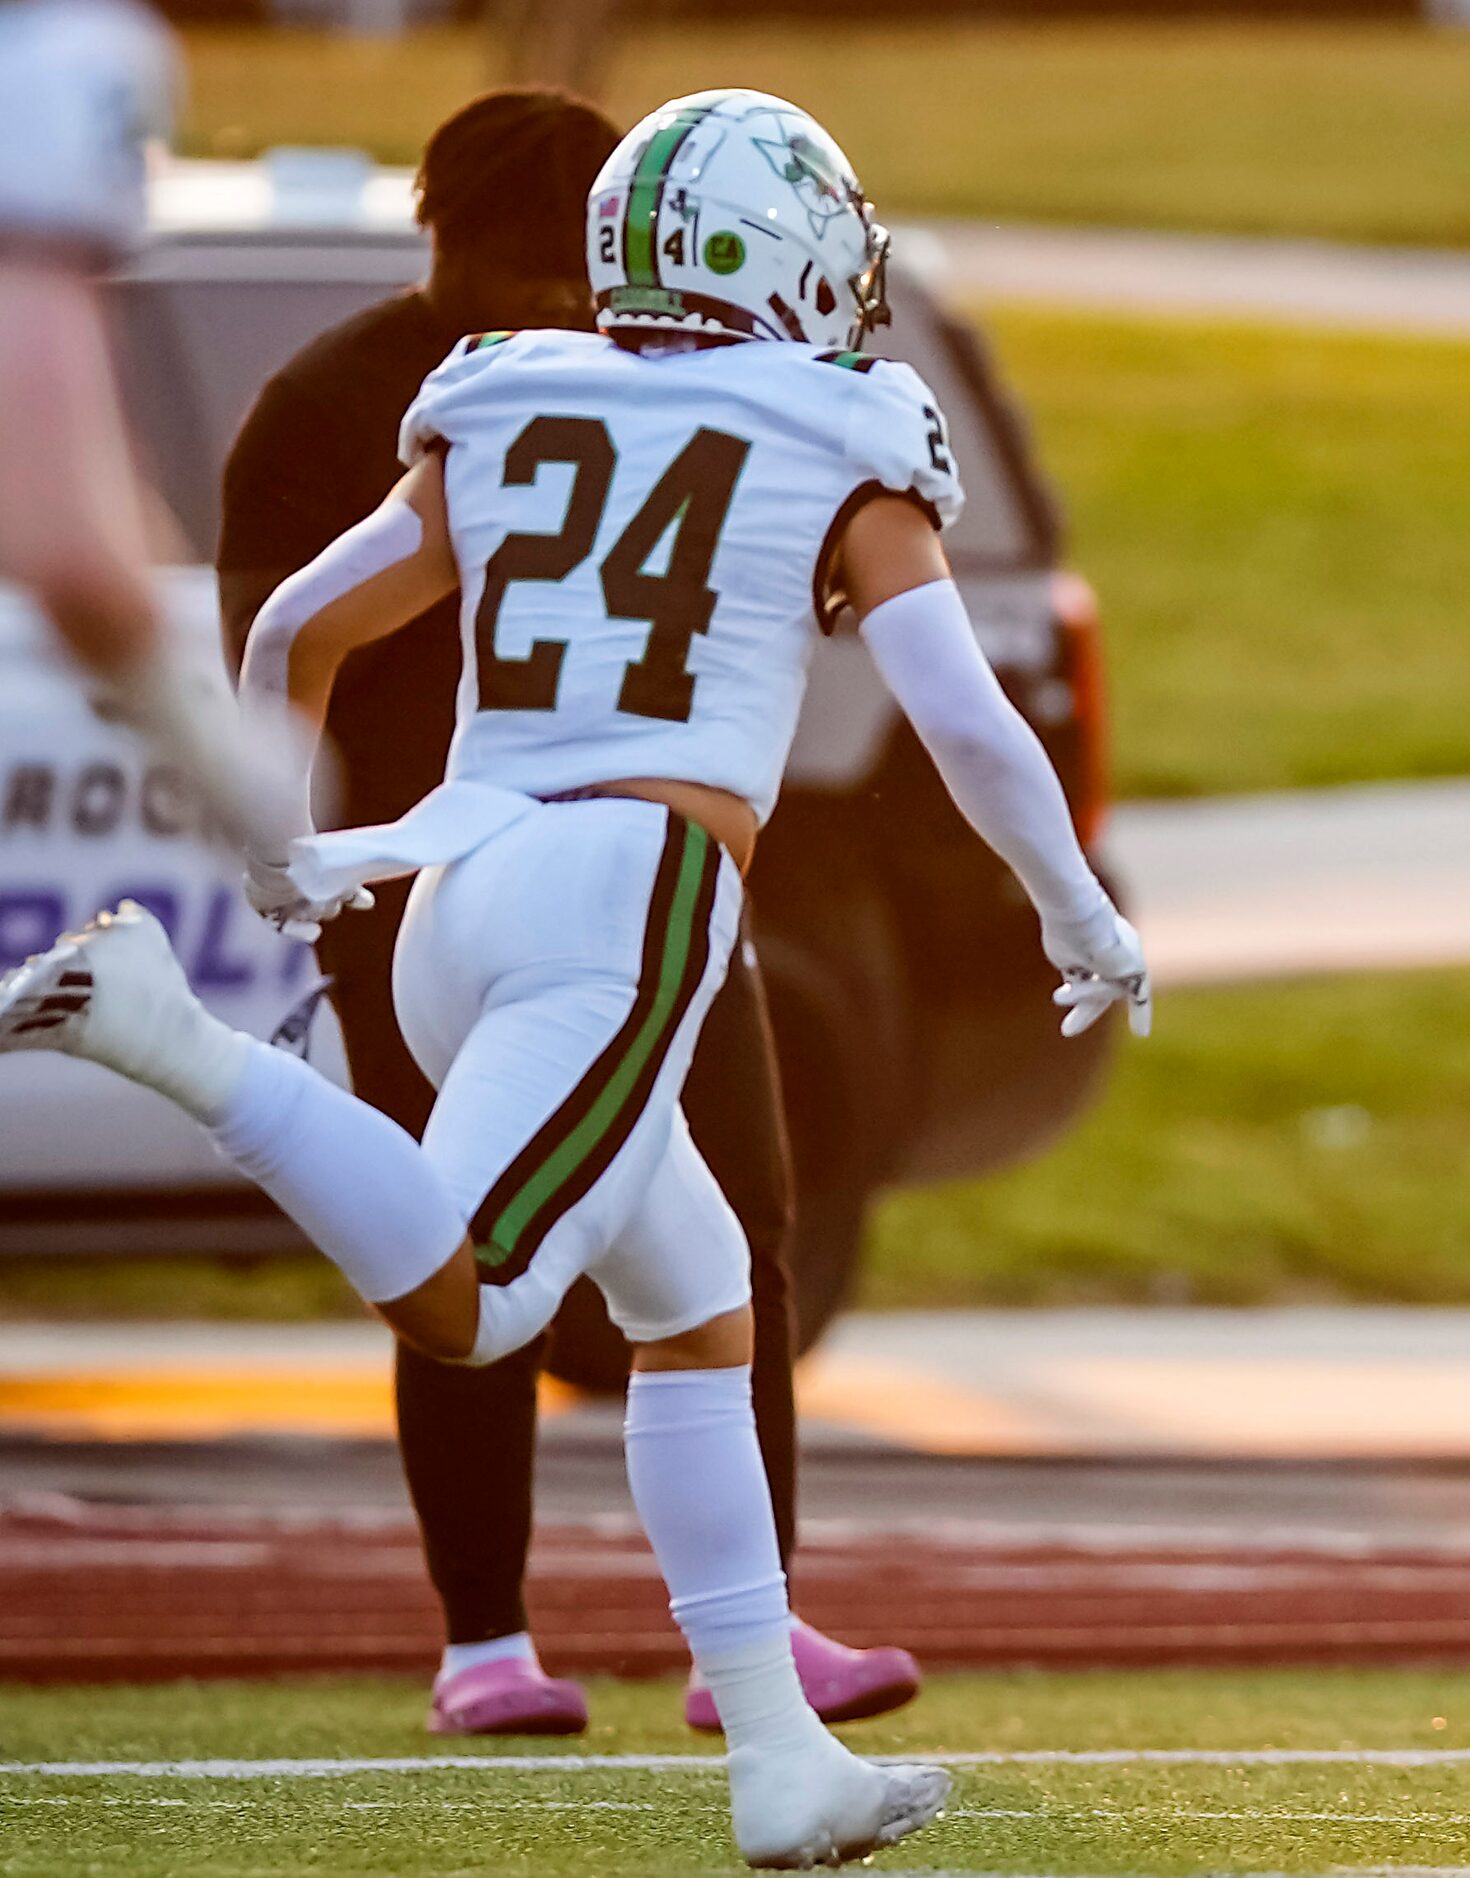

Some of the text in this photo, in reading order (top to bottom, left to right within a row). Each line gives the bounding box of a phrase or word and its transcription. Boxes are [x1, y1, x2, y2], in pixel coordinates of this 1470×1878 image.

[599, 226, 685, 267] 2 4
[475, 412, 753, 723] 24
